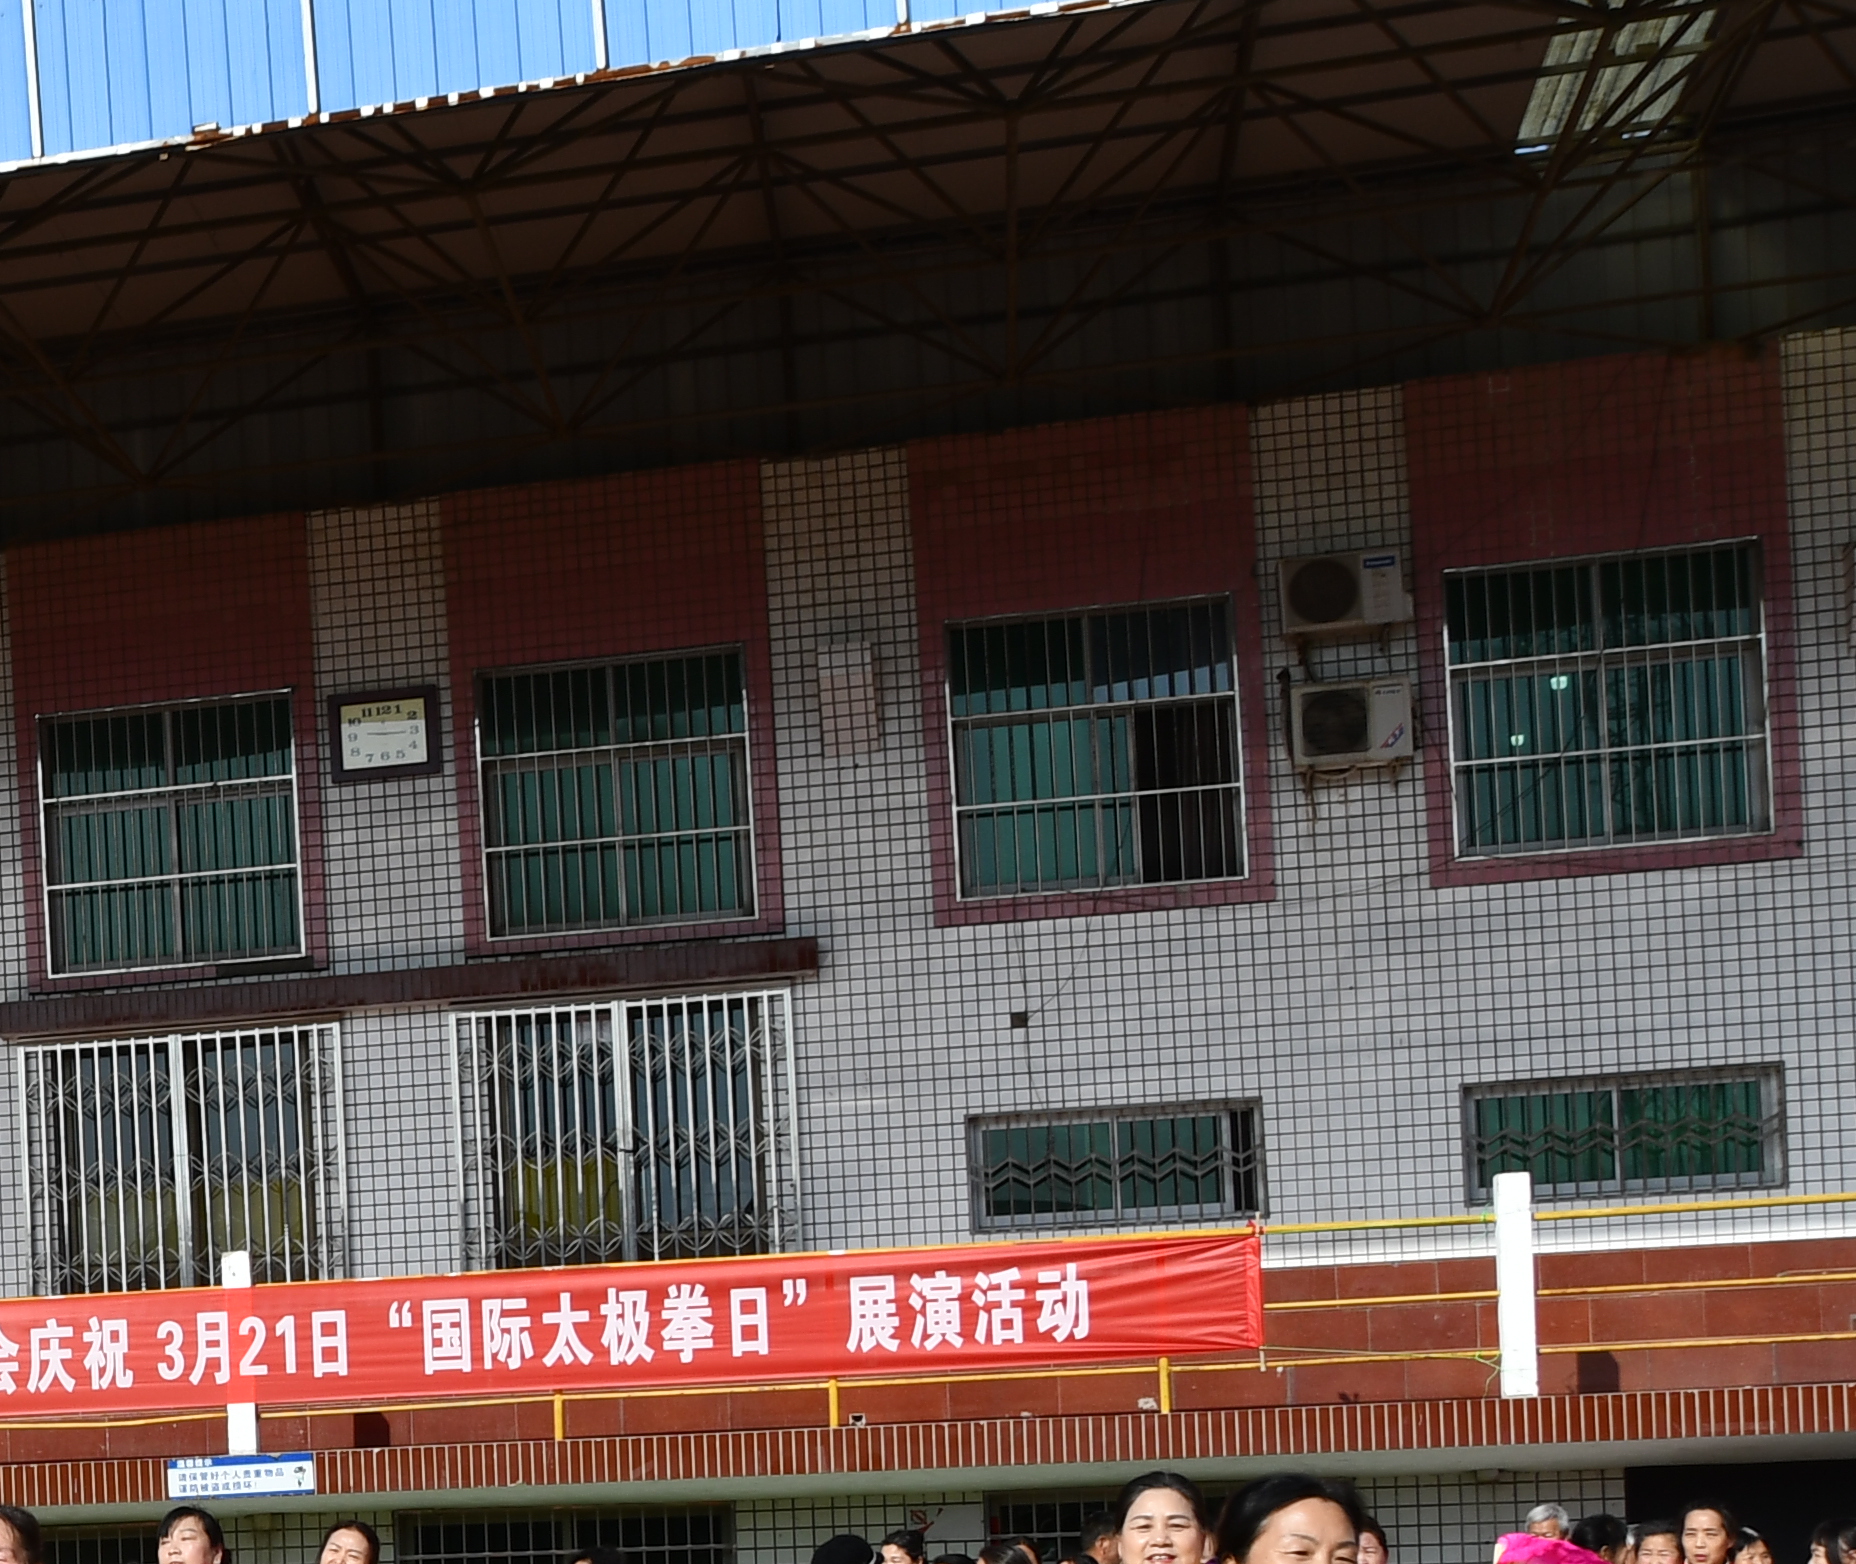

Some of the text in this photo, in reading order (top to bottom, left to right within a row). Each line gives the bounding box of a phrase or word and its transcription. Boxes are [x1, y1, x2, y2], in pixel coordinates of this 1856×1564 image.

[361, 707, 372, 718] 11
[376, 705, 392, 717] 12
[394, 704, 402, 714] 1
[406, 710, 418, 720] 2
[347, 717, 362, 727] 10
[409, 725, 419, 735] 3
[348, 732, 358, 743] 9
[408, 740, 418, 750] 4
[350, 746, 361, 757] 8
[380, 751, 391, 761] 6
[395, 749, 406, 760] 5
[365, 753, 375, 764] 7
[156, 1309, 348, 1384] 3月21日
[389, 1278, 807, 1375] “国际太极拳日”
[846, 1262, 1090, 1352] 展演活动
[178, 1467, 284, 1482] 请保管好个人贵重物品
